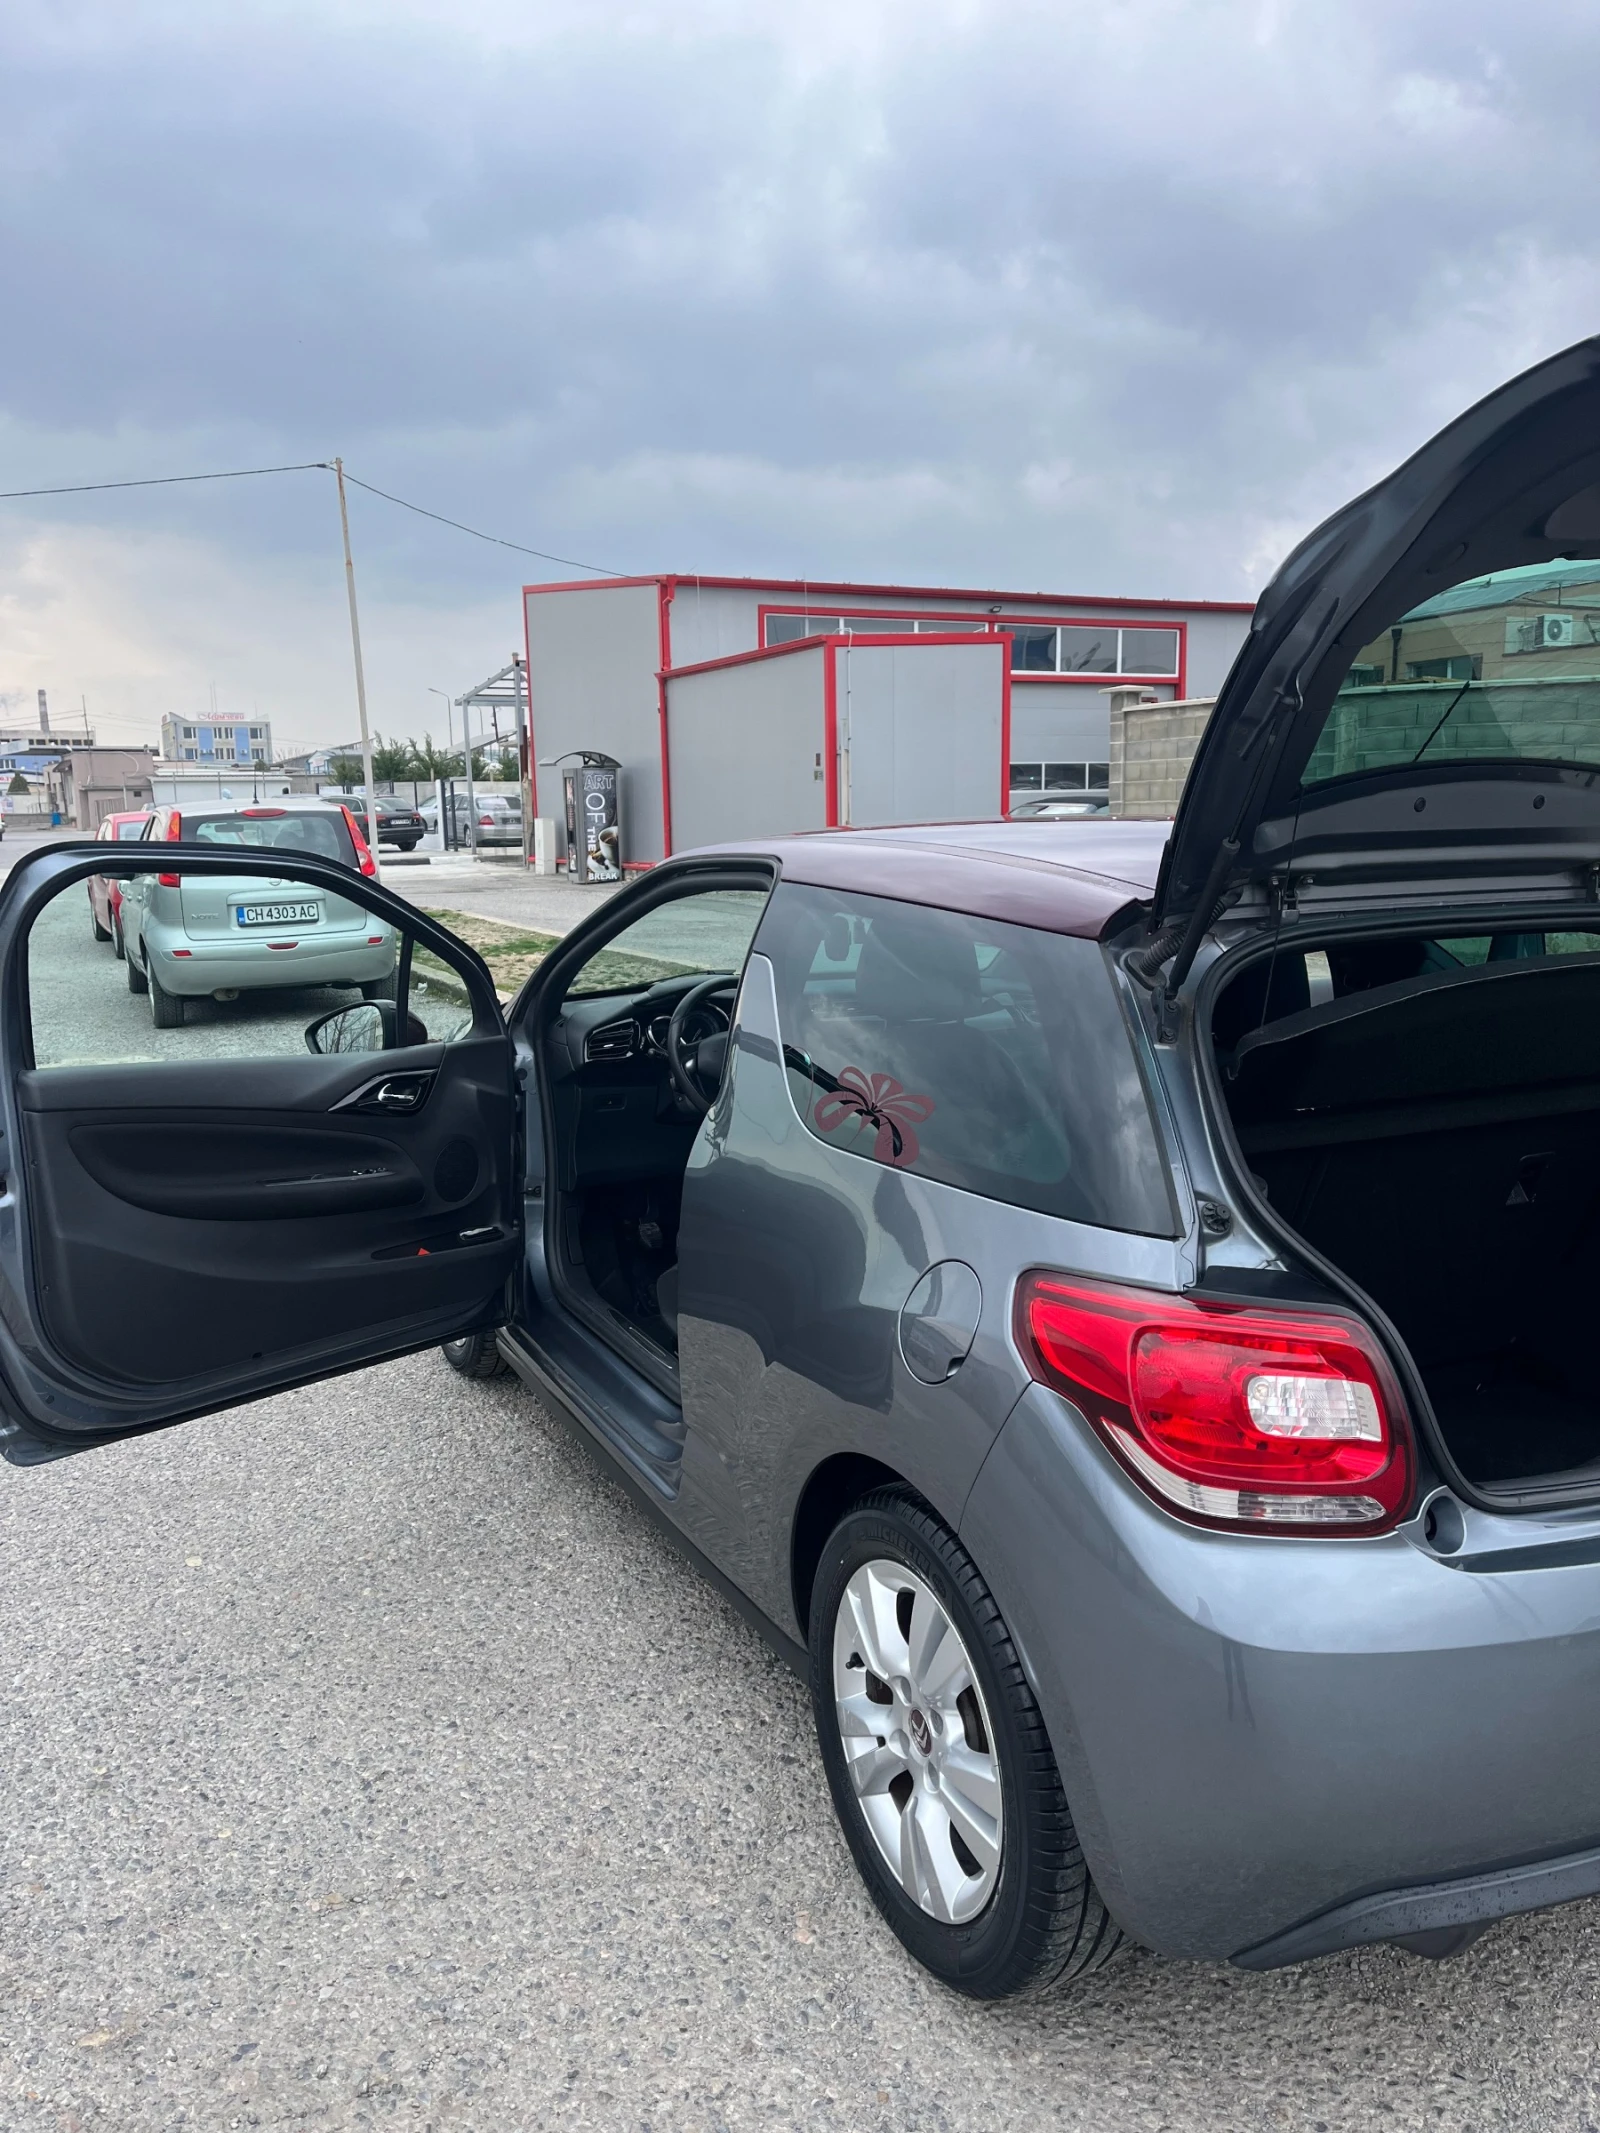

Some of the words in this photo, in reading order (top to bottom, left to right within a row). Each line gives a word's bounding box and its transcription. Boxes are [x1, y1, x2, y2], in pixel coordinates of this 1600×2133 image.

[584, 774, 614, 790] ART
[586, 792, 606, 824] OF
[587, 826, 597, 852] THE
[588, 871, 618, 881] BREAK
[246, 908, 264, 922] CH
[266, 906, 297, 920] 4303
[299, 905, 316, 918] AC
[866, 1522, 931, 1579] MICHELIN
